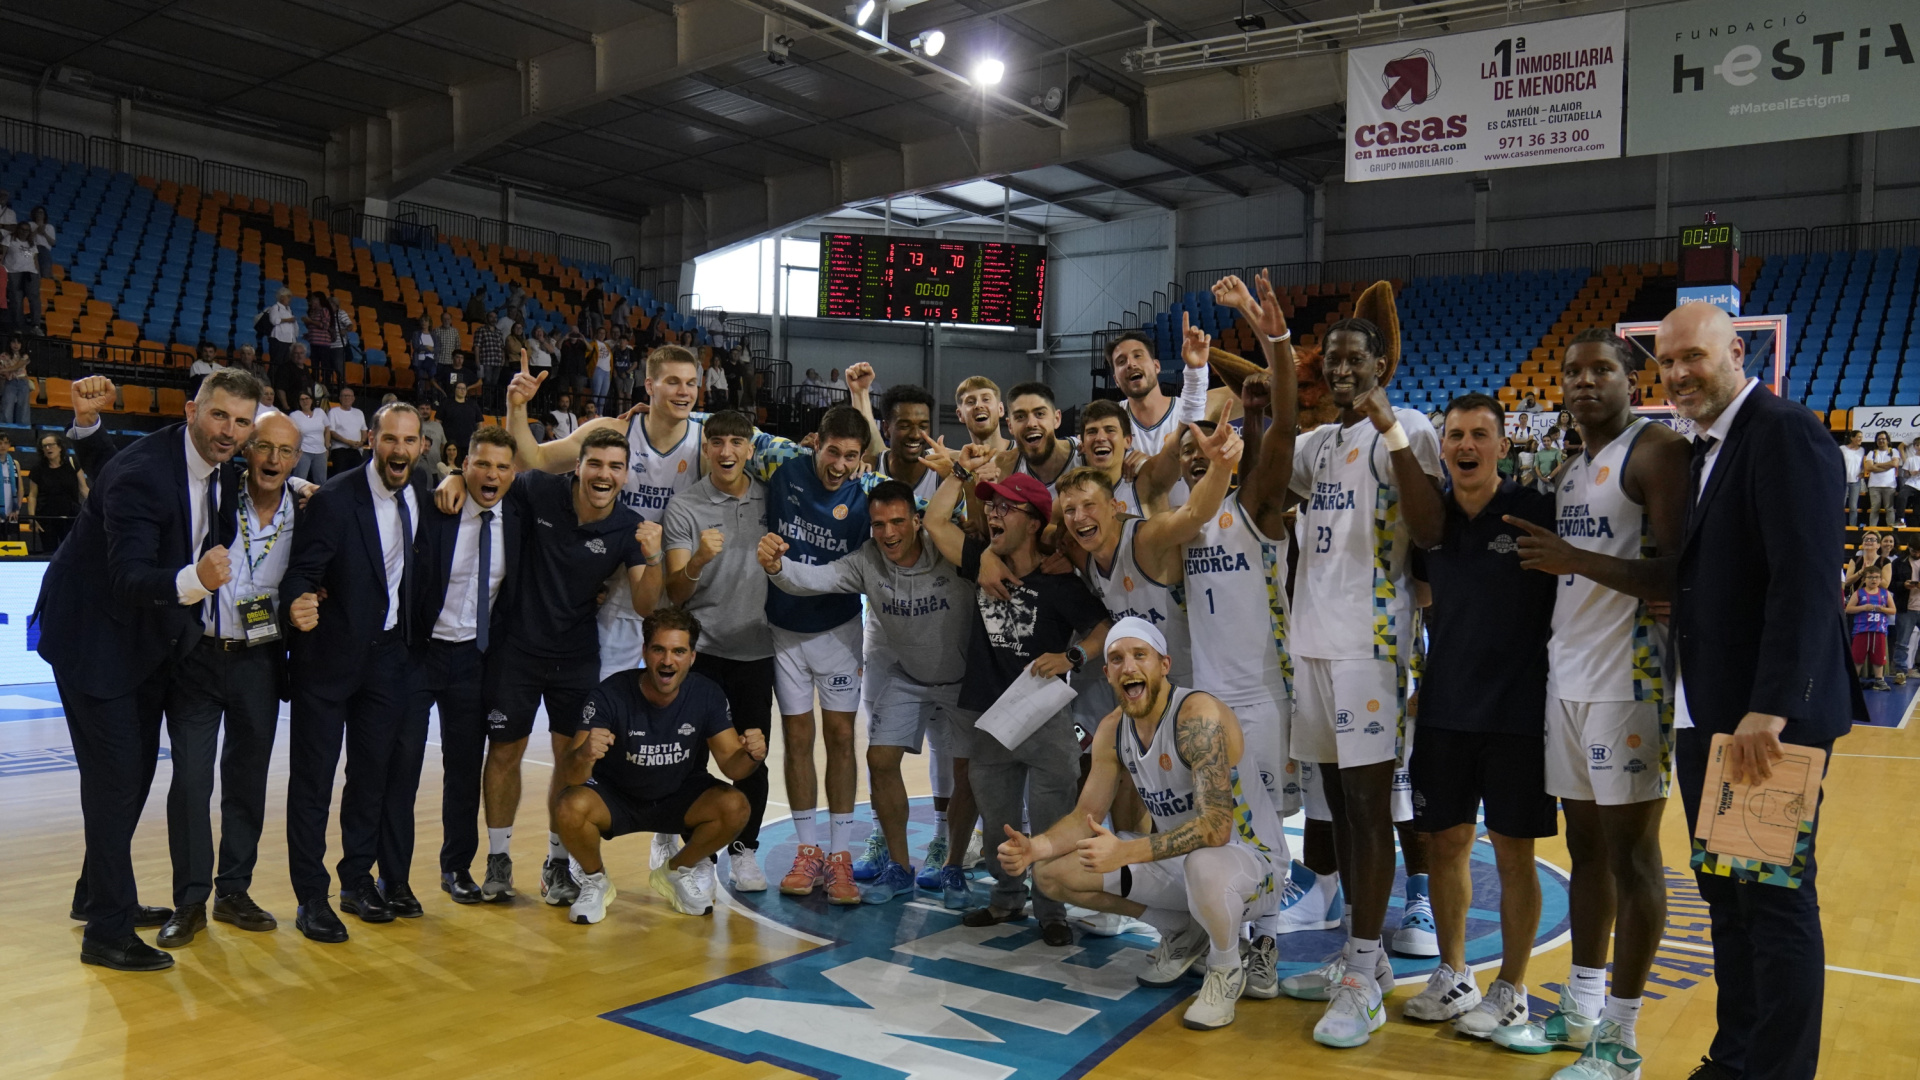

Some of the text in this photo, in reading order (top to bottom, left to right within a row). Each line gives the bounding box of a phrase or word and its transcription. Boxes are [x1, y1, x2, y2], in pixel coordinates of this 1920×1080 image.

[1675, 11, 1808, 42] FUNDACIÓ
[1481, 61, 1498, 80] LA
[1515, 46, 1614, 76] INMOBILIARIA
[1493, 69, 1597, 101] DE MENORCA
[1507, 105, 1540, 118] MAHÓN
[1549, 101, 1583, 113] ALAIOR
[1728, 92, 1851, 117] #MatealEstigma
[1487, 121, 1498, 131] ES
[1500, 117, 1538, 129] CASTELL
[1548, 109, 1603, 124] CIUTADELLA
[1354, 114, 1468, 148] casas
[1499, 128, 1590, 149] 971 36 33 00
[1354, 142, 1467, 160] en menorca.com
[1484, 142, 1605, 161] www.casasenmenorca.com
[1369, 157, 1454, 173] GRUPO INMOBILIARIO
[1682, 227, 1730, 246] 00:00
[909, 252, 924, 266] 73
[950, 254, 965, 268] 70
[930, 266, 938, 276] 4
[915, 283, 950, 297] 00:00
[904, 305, 911, 317] 5
[951, 308, 958, 319] 5
[1532, 414, 1557, 428] Fus
[1861, 411, 1903, 430] Jose
[777, 517, 849, 553] MENORCA
[793, 514, 833, 538] HESTIA
[1315, 526, 1333, 554] 23
[1188, 544, 1226, 559] HESTIA
[892, 594, 937, 608] HESTIA
[1205, 587, 1215, 615] 1
[1867, 612, 1880, 622] 28
[625, 748, 691, 767] MENORCA
[639, 742, 683, 755] HESTIA
[1716, 781, 1731, 816] MENORCA
